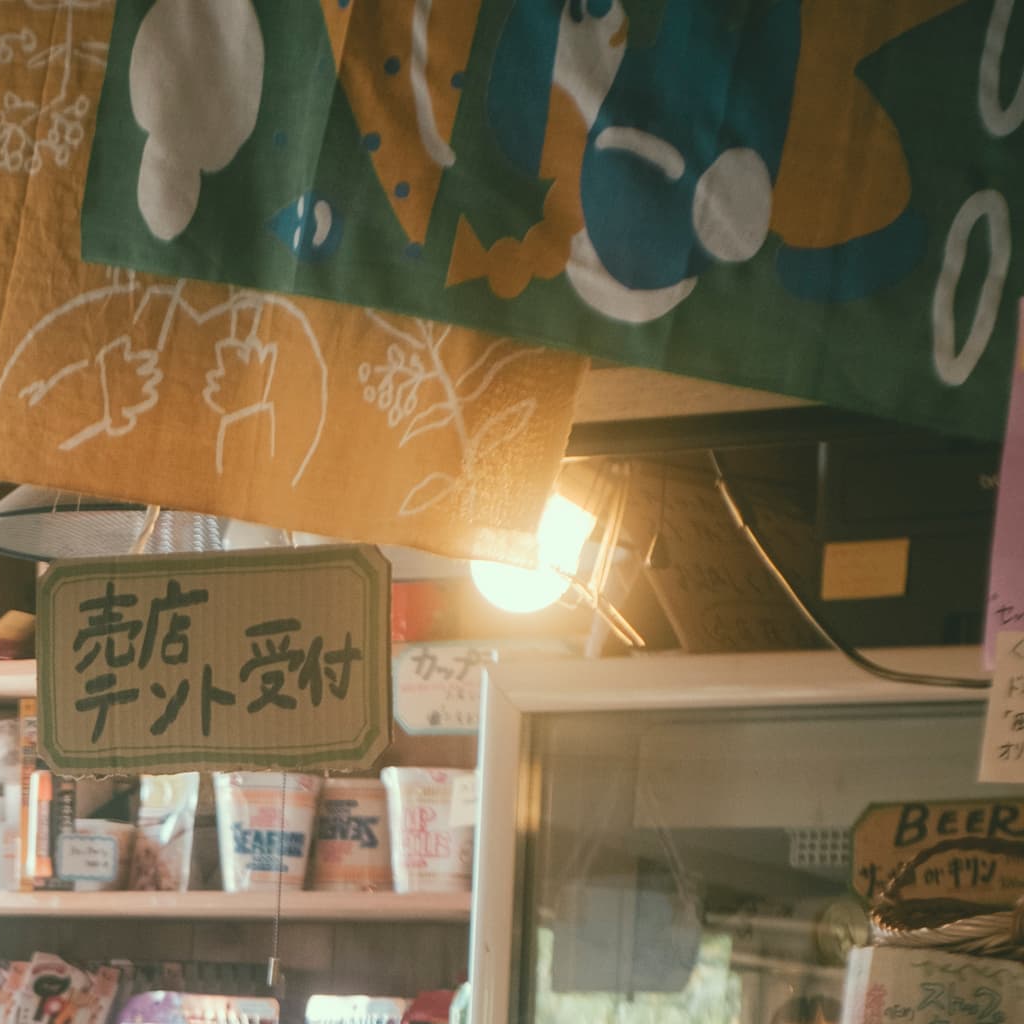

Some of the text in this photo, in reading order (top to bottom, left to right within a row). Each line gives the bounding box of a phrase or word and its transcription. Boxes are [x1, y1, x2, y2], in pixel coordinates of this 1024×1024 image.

[74, 579, 208, 674] 売店
[239, 617, 363, 714] 受付
[75, 664, 236, 744] テント
[895, 802, 1024, 848] BEER
